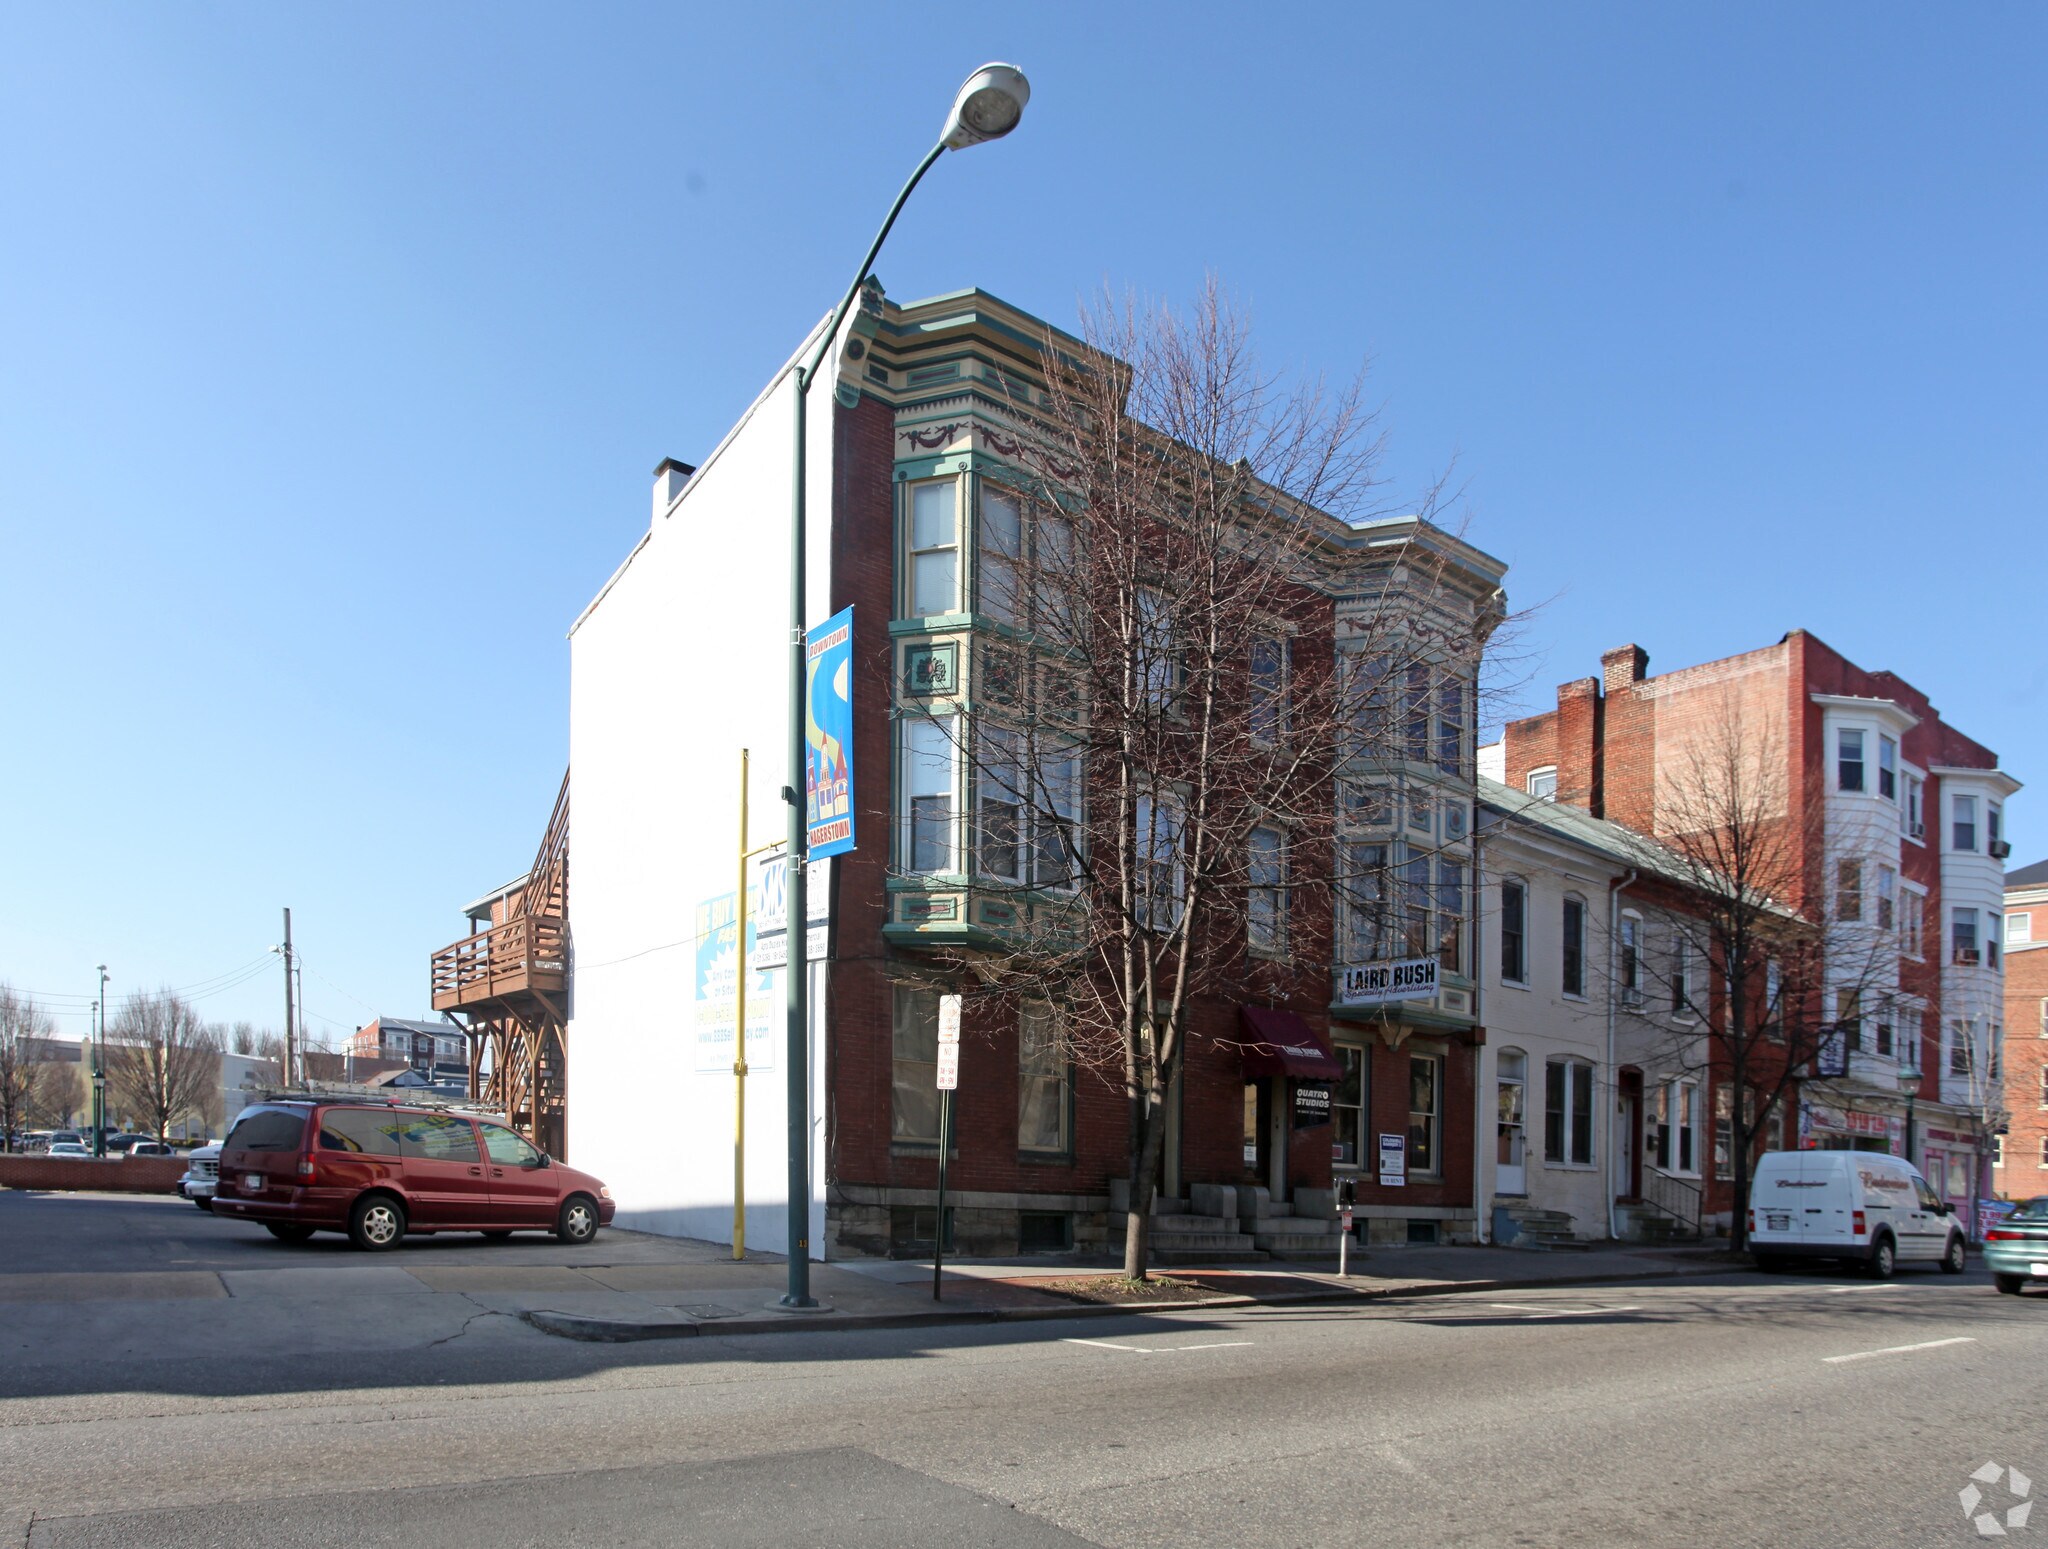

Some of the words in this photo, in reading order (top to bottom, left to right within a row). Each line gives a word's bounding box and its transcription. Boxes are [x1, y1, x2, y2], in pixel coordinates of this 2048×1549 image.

[810, 627, 847, 657] DOWNTOWN
[810, 819, 850, 846] HAGERSTOWN
[1347, 968, 1389, 990] LAIRD
[1394, 963, 1435, 986] BUSH
[1384, 984, 1434, 996] Advertising
[1296, 1097, 1330, 1108] STUDIOS
[1297, 1088, 1329, 1100] QUATRO
[1858, 1170, 1910, 1190] Budweiser
